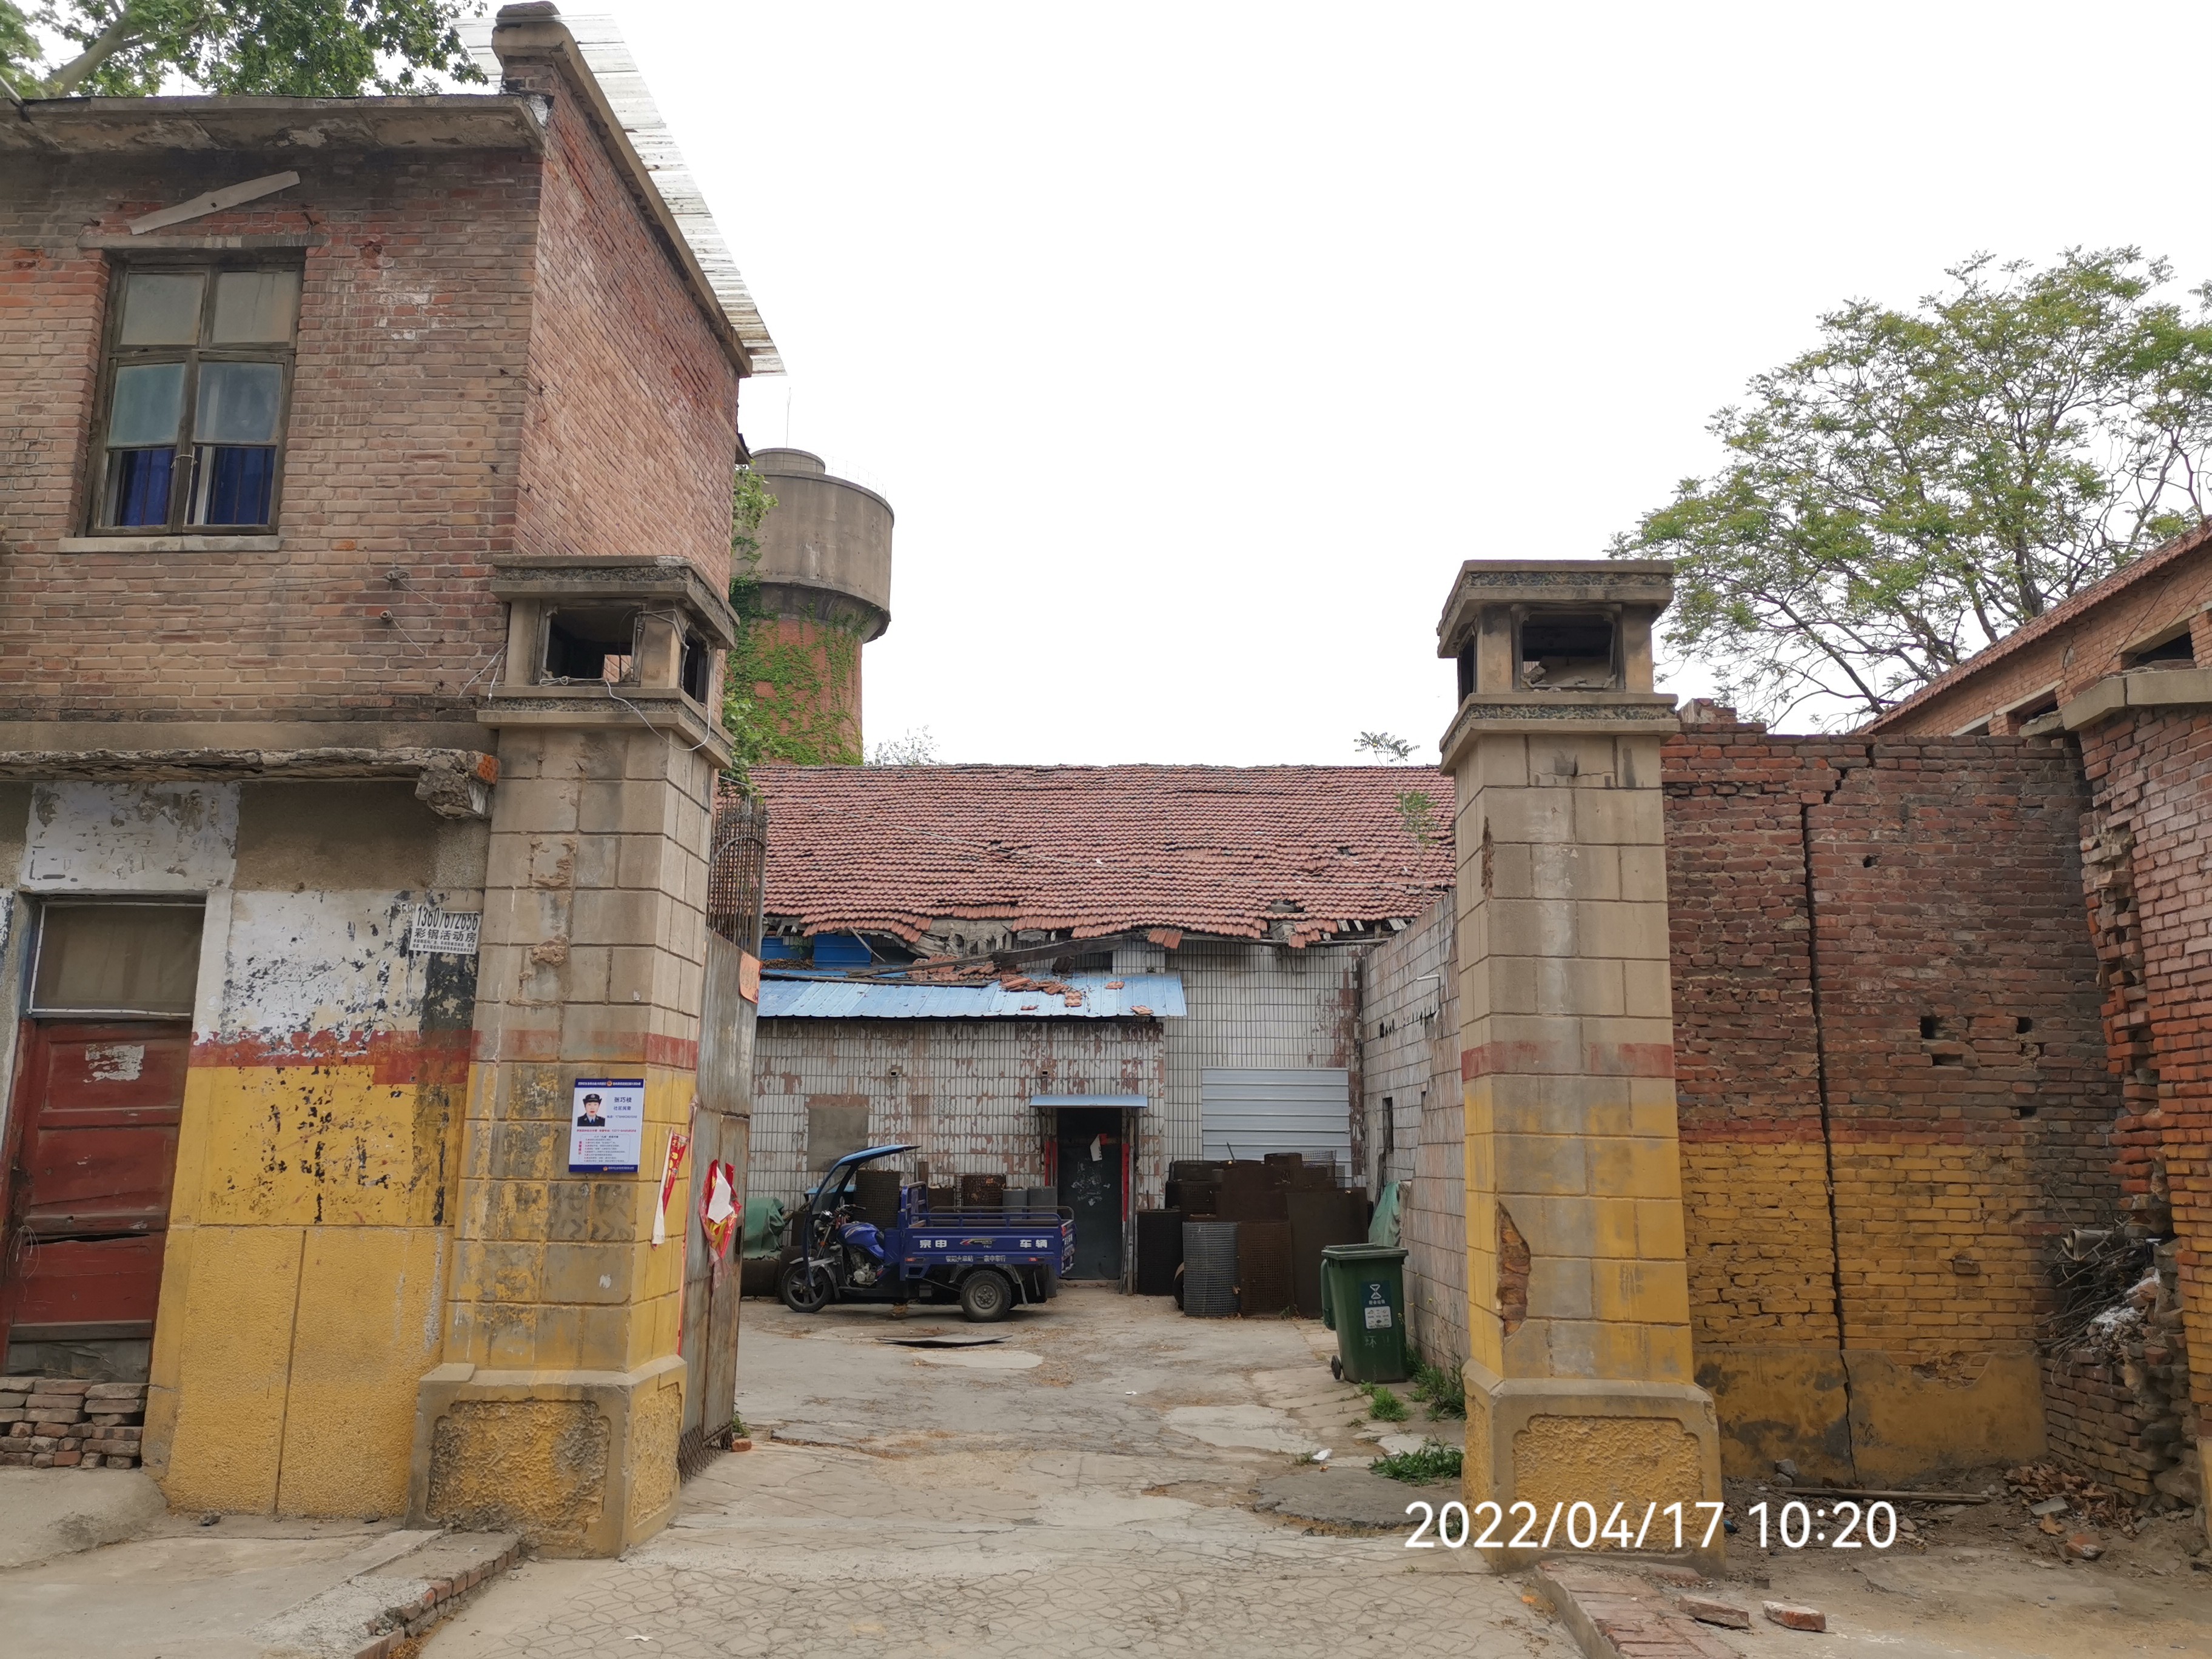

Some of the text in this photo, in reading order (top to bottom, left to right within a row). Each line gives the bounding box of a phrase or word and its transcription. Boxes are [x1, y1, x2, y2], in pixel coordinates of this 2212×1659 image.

[415, 928, 477, 942] 彩钢活动房
[919, 1239, 1048, 1248] 宗申 车辆
